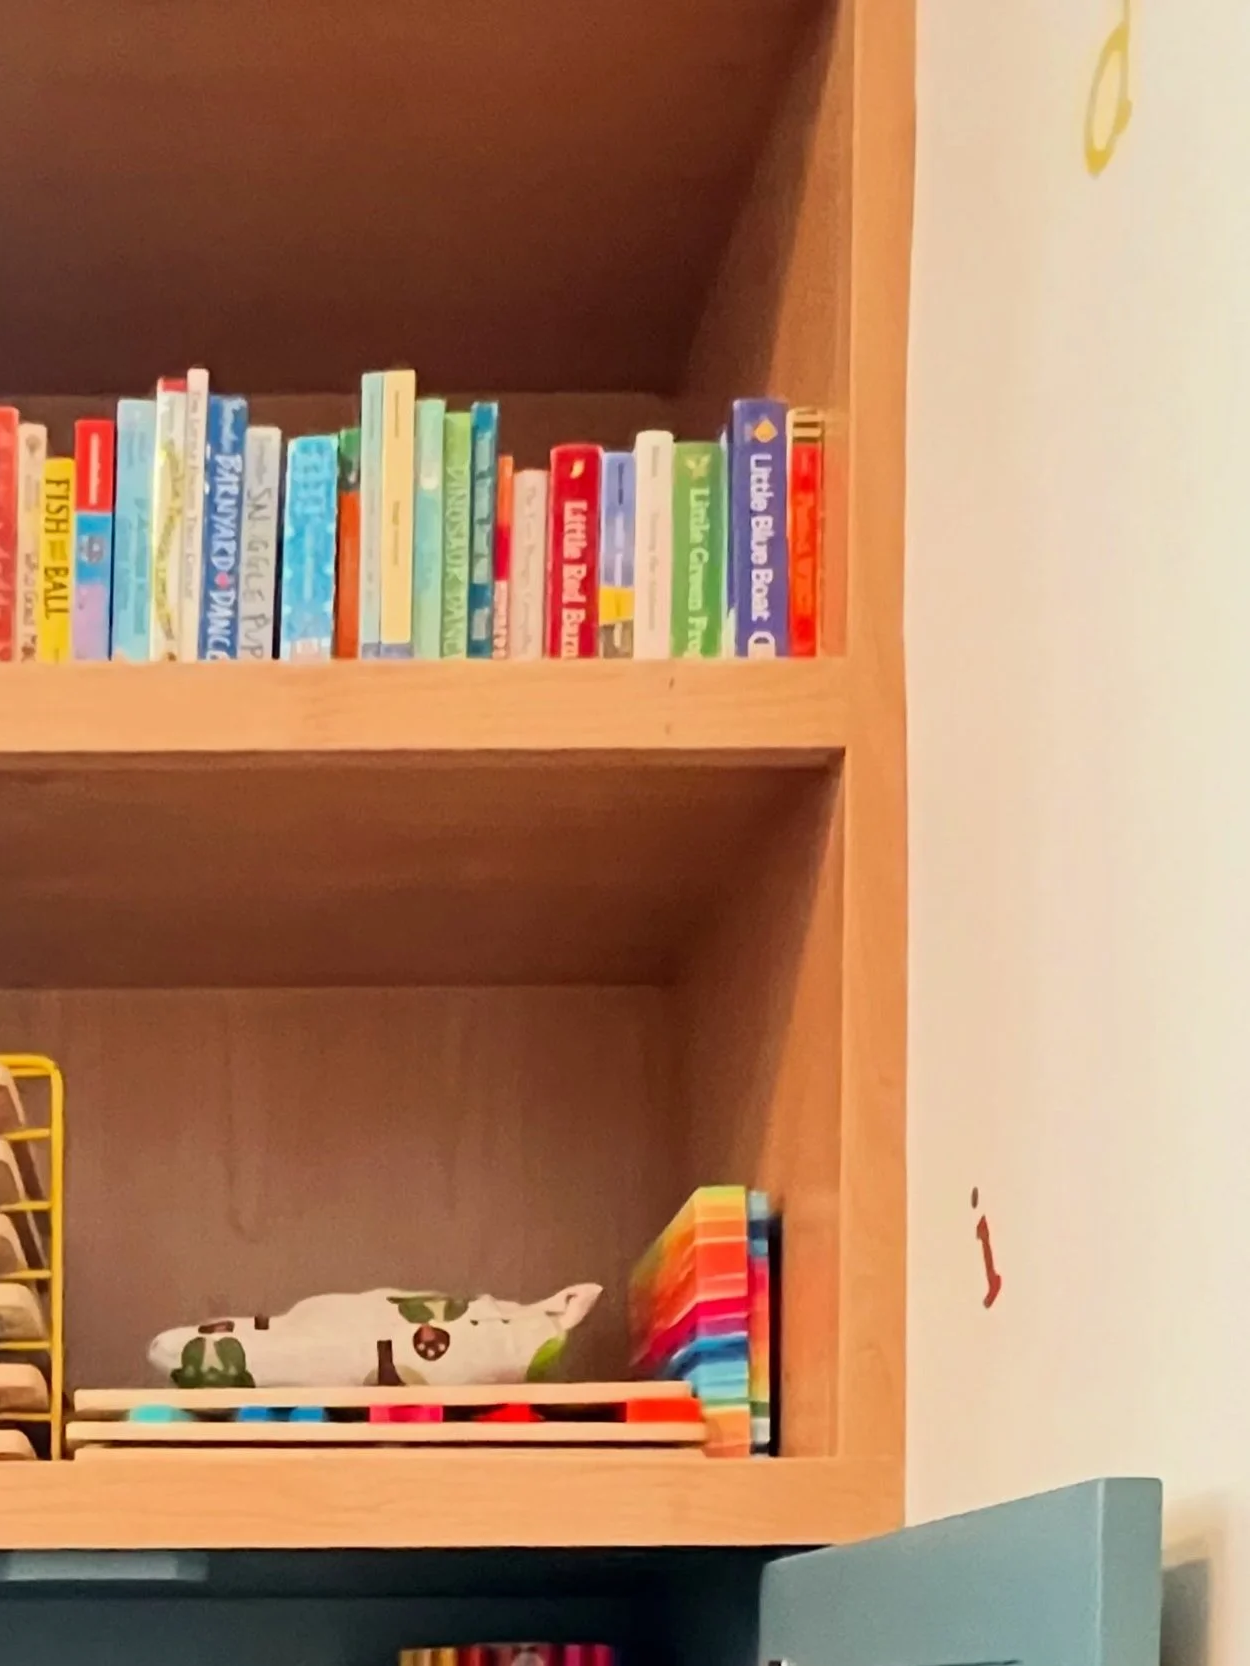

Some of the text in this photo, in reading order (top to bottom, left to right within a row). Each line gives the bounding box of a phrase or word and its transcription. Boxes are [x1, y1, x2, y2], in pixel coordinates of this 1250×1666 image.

[43, 478, 71, 535] FISH
[209, 453, 243, 572] BARNYARD
[562, 499, 589, 560] Little
[689, 487, 711, 544] Little
[244, 487, 273, 602] SNGGLE
[749, 453, 775, 622] Little Blue Boat
[43, 565, 71, 621] BALL
[561, 563, 587, 604] Red
[688, 547, 710, 611] Green
